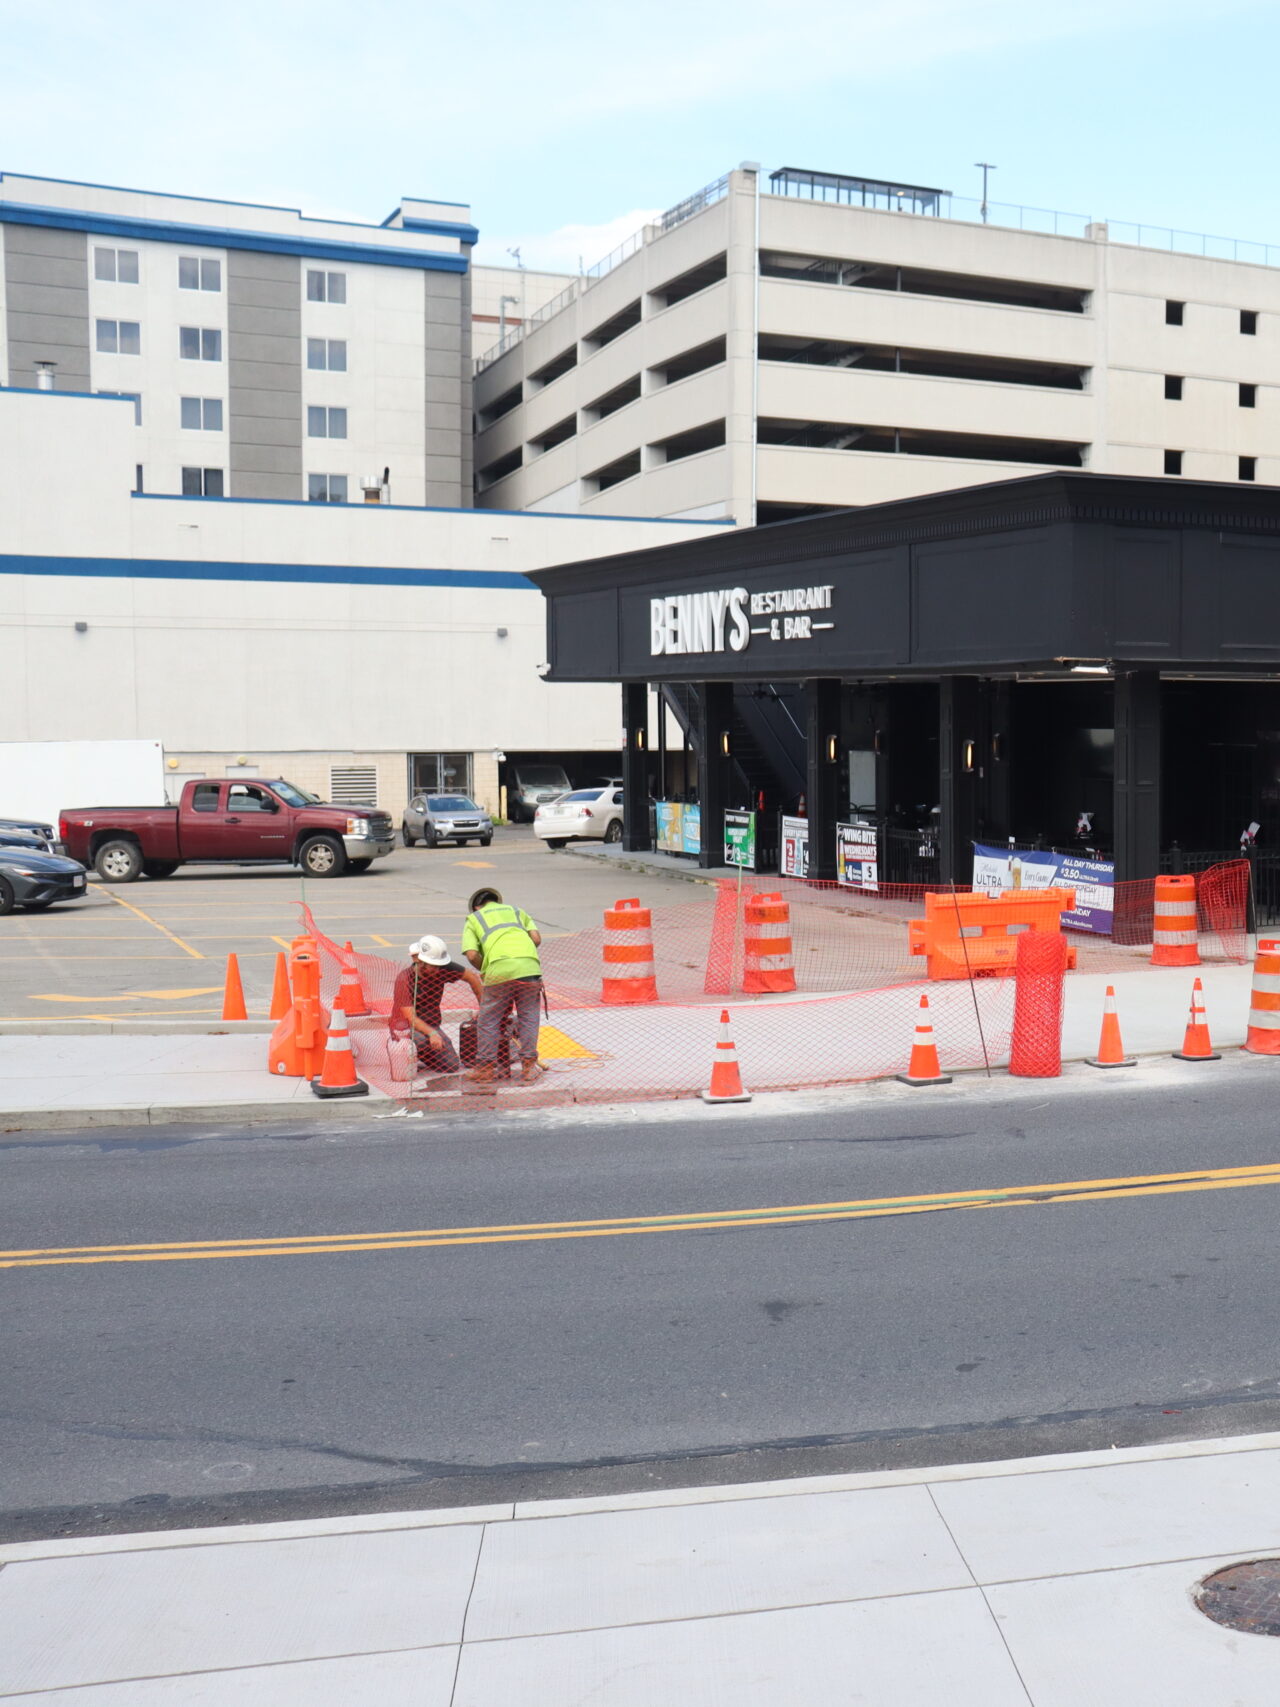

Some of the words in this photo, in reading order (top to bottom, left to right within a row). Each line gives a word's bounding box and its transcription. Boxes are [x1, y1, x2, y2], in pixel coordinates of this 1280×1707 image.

[650, 587, 749, 656] BENNY'S
[751, 585, 834, 615] RESTAURANT
[770, 618, 781, 640] &
[784, 616, 812, 640] BAR
[844, 828, 861, 843] WING
[862, 830, 876, 845] BITE
[844, 844, 877, 856] WEDNESDAYS
[1061, 867, 1080, 879] $3.50
[1063, 858, 1073, 867] ALL
[1074, 860, 1086, 868] DAY
[1086, 861, 1114, 873] THURSDAY
[976, 873, 1002, 887] ULTRA
